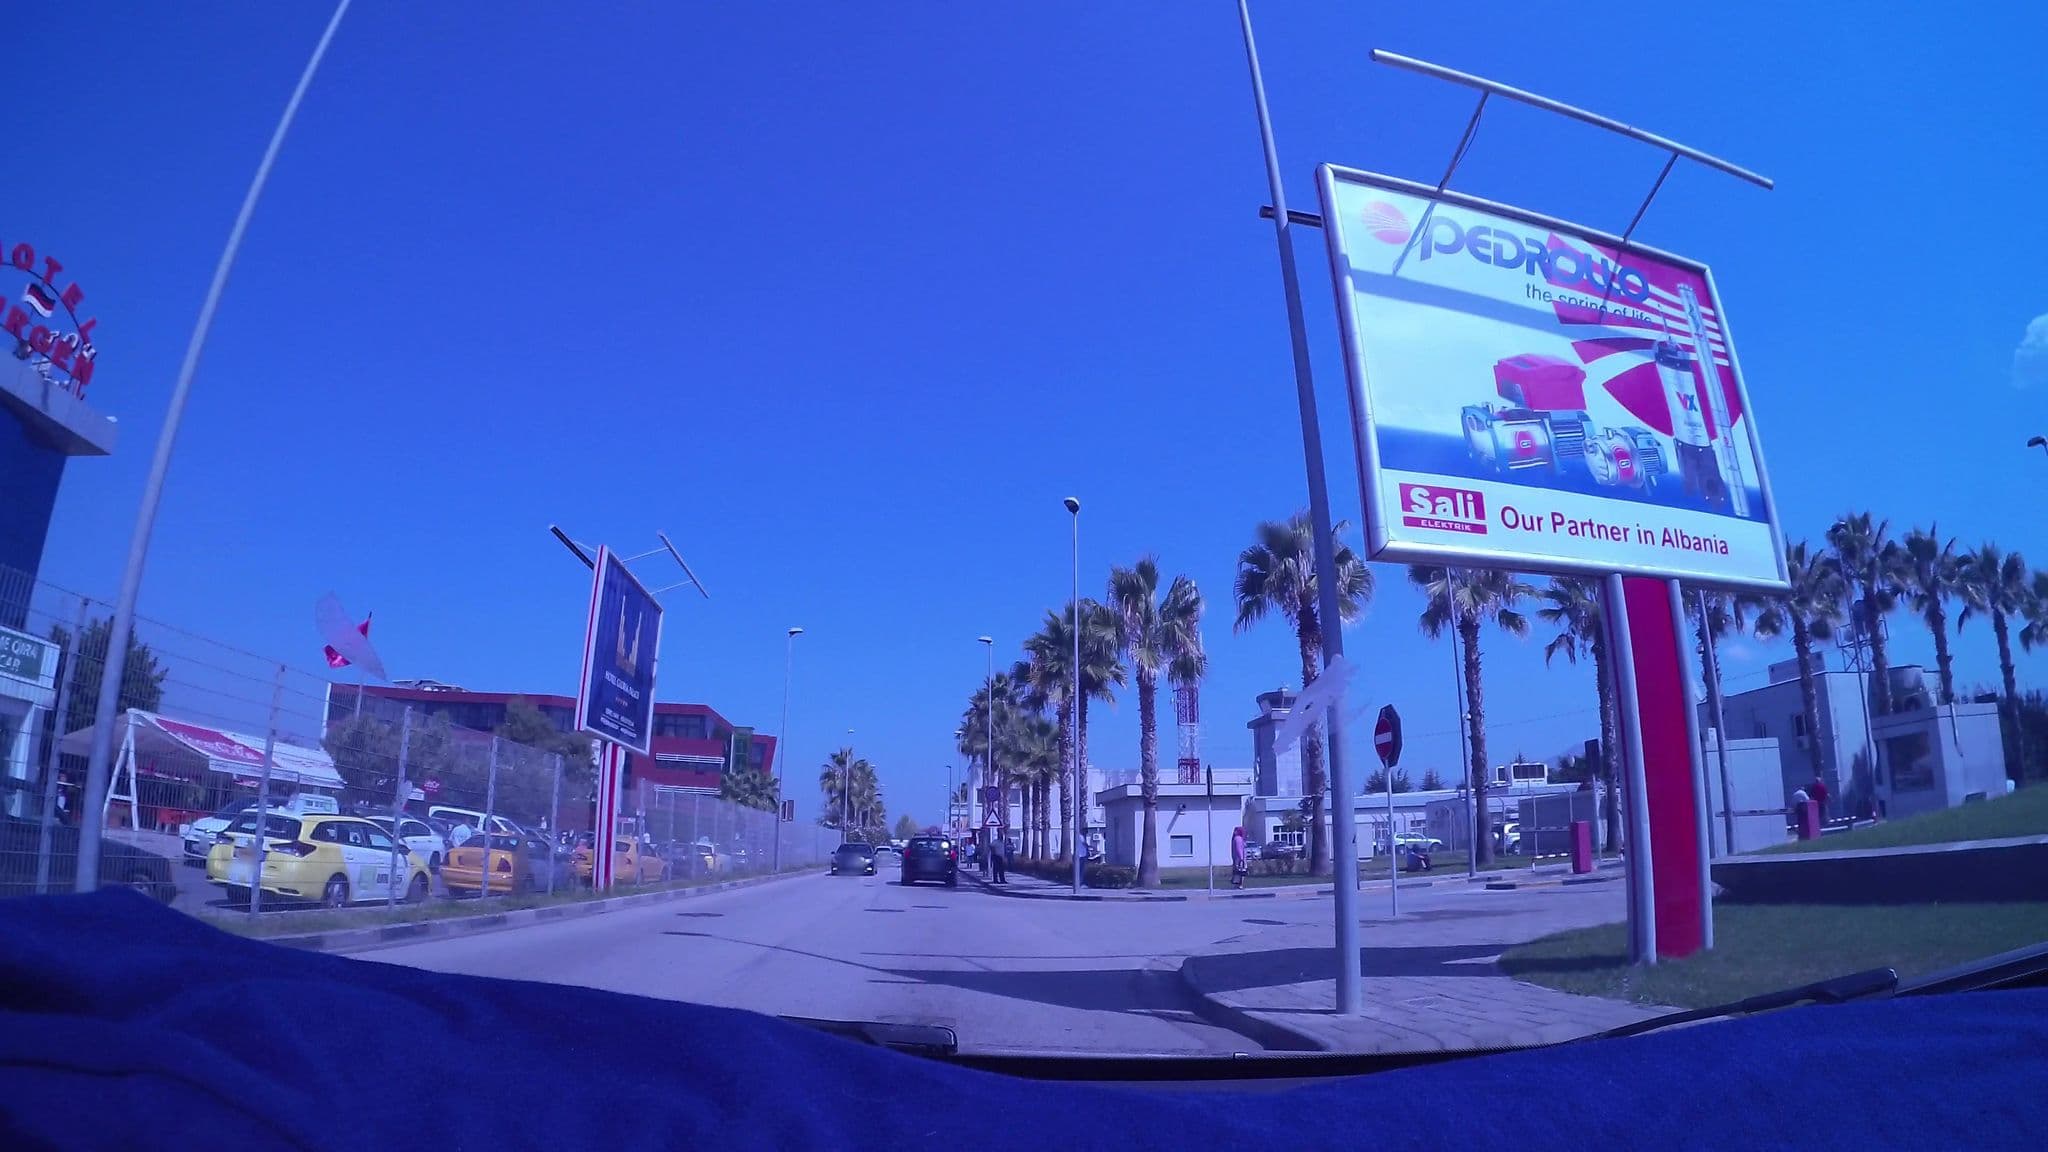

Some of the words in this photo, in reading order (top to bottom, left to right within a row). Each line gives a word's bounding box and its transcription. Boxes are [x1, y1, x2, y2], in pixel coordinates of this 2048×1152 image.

[1420, 215, 1650, 303] PEDROLLO
[0, 241, 97, 344] OTEL
[1526, 283, 1553, 303] the
[1410, 487, 1475, 521] Sali
[1421, 519, 1471, 531] ELEKTRIK
[1501, 506, 1544, 532] Our
[1551, 512, 1630, 543] Partner
[1636, 523, 1655, 546] in
[1662, 527, 1729, 555] Albania
